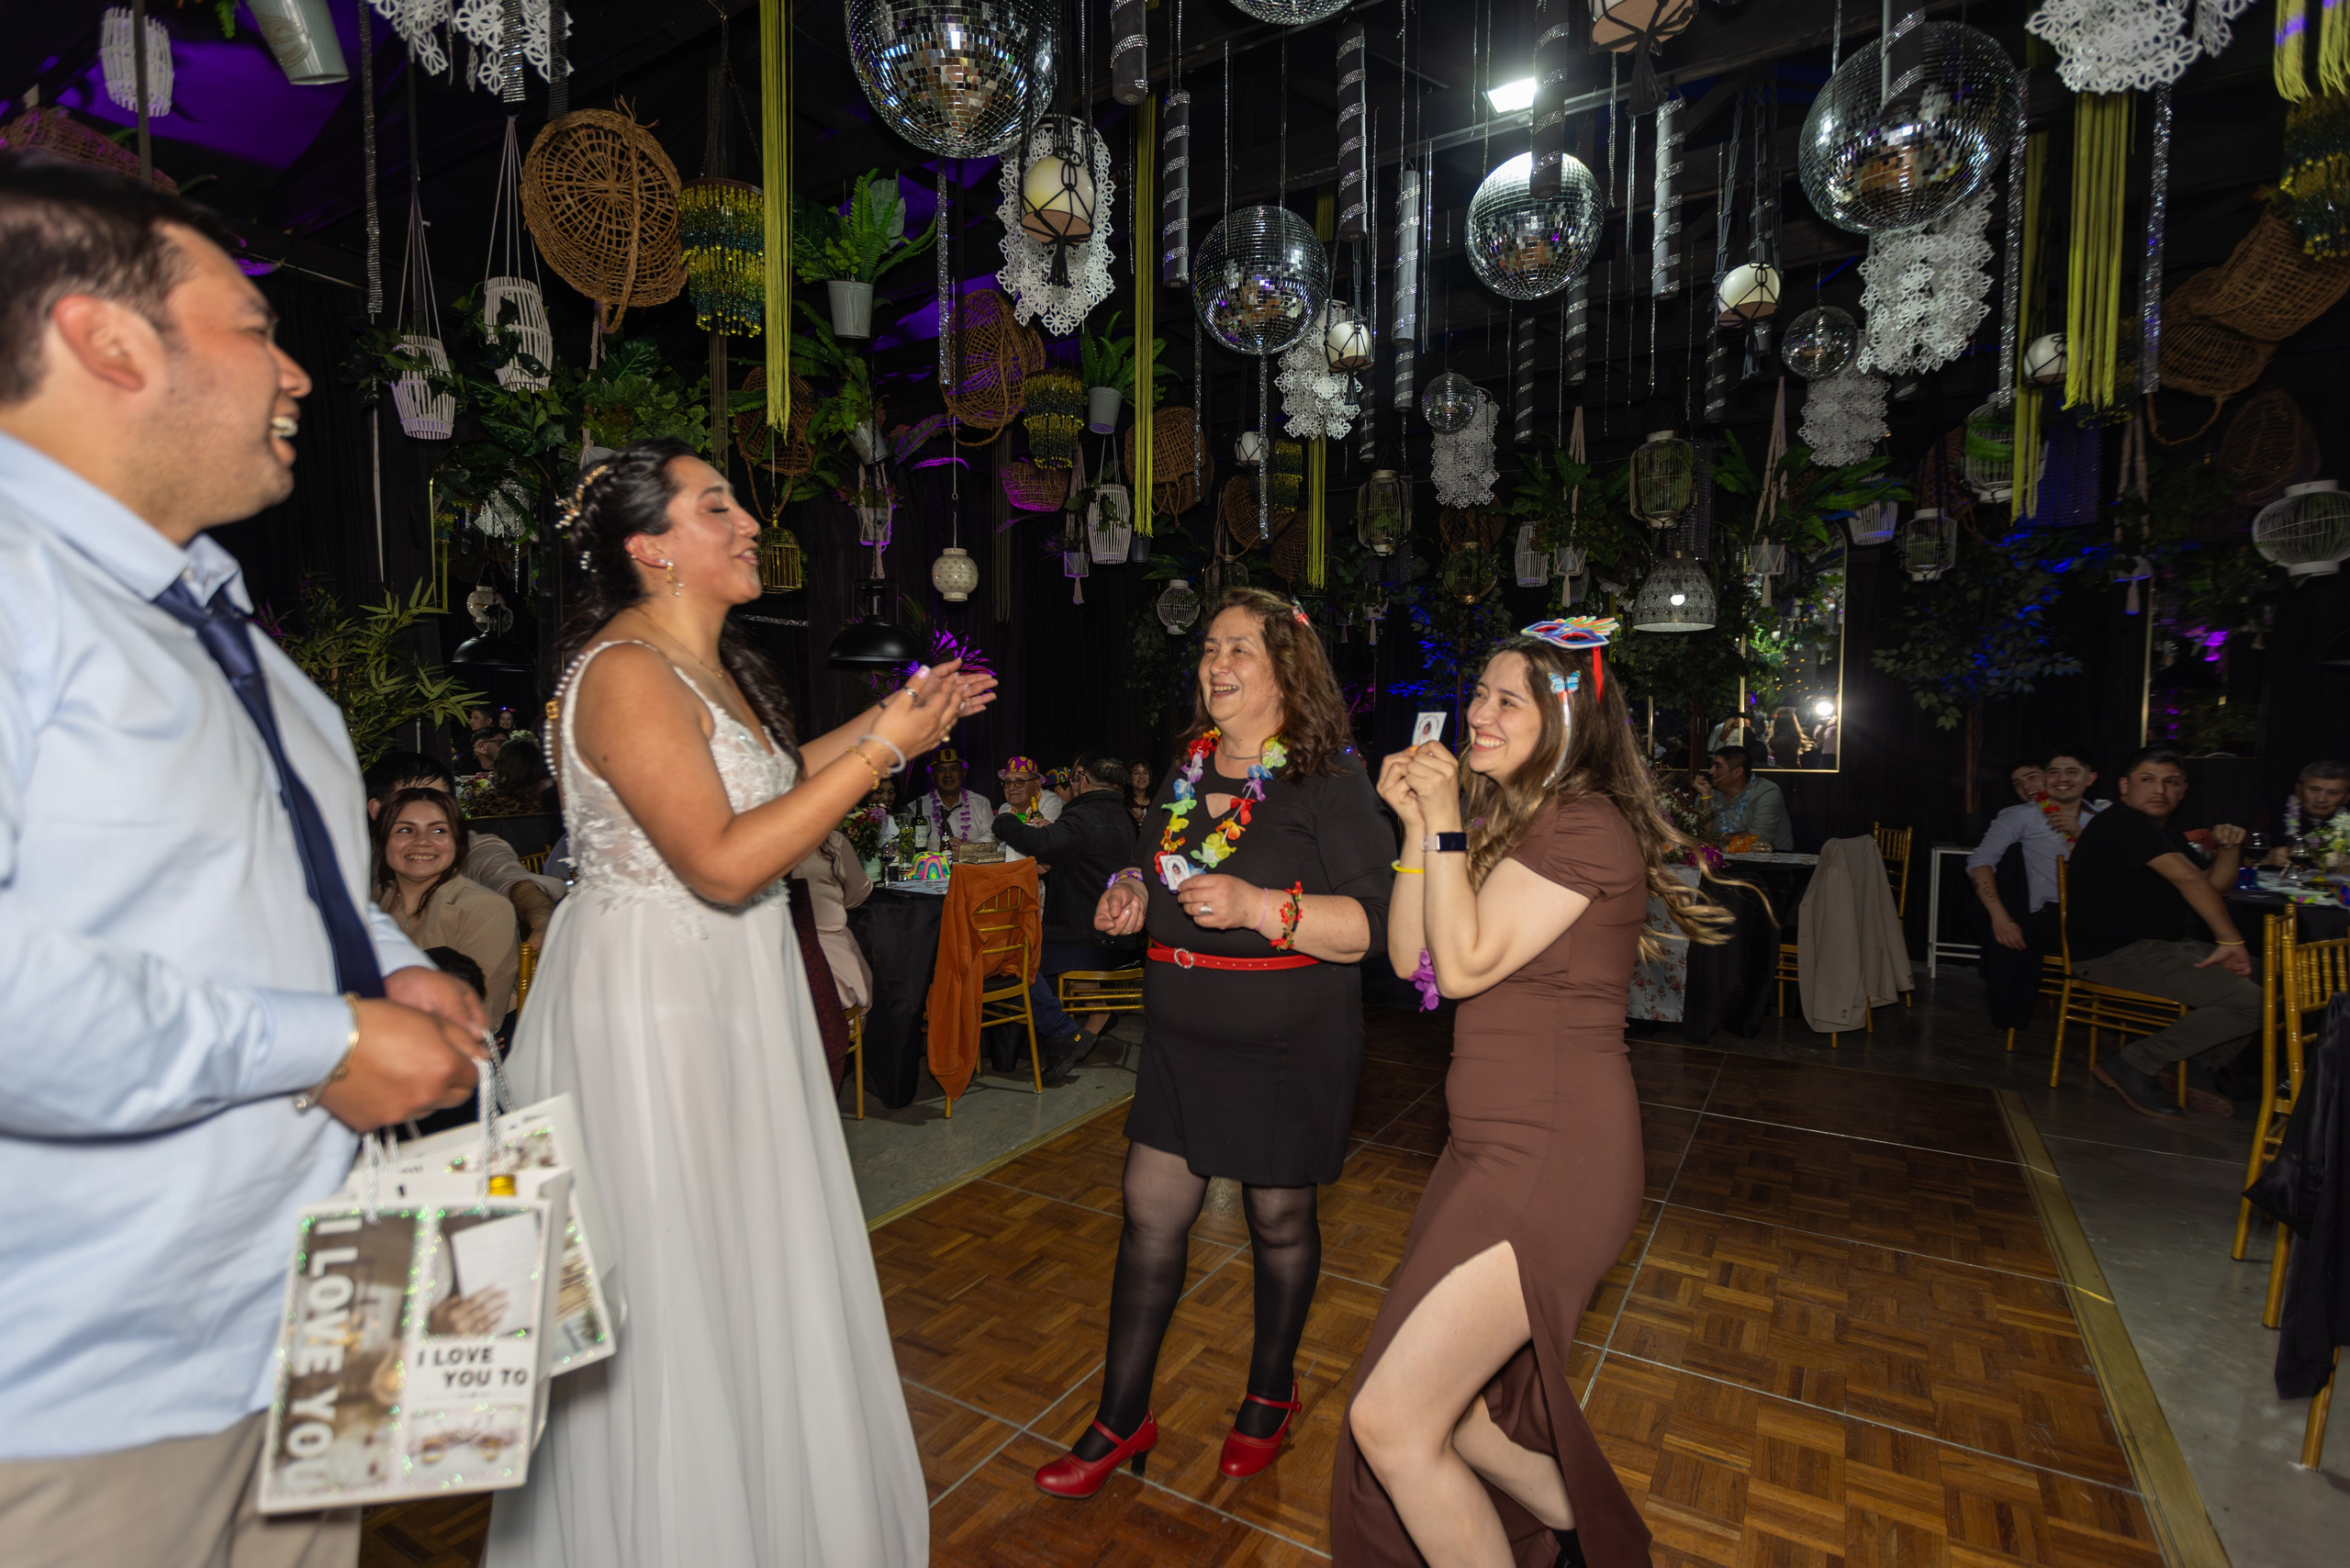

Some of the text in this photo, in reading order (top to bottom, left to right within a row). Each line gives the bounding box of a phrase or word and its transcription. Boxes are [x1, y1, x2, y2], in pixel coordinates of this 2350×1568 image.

[283, 1217, 364, 1489] I LOVE YOU
[417, 1346, 494, 1367] I LOVE
[444, 1369, 528, 1389] YOU TO
